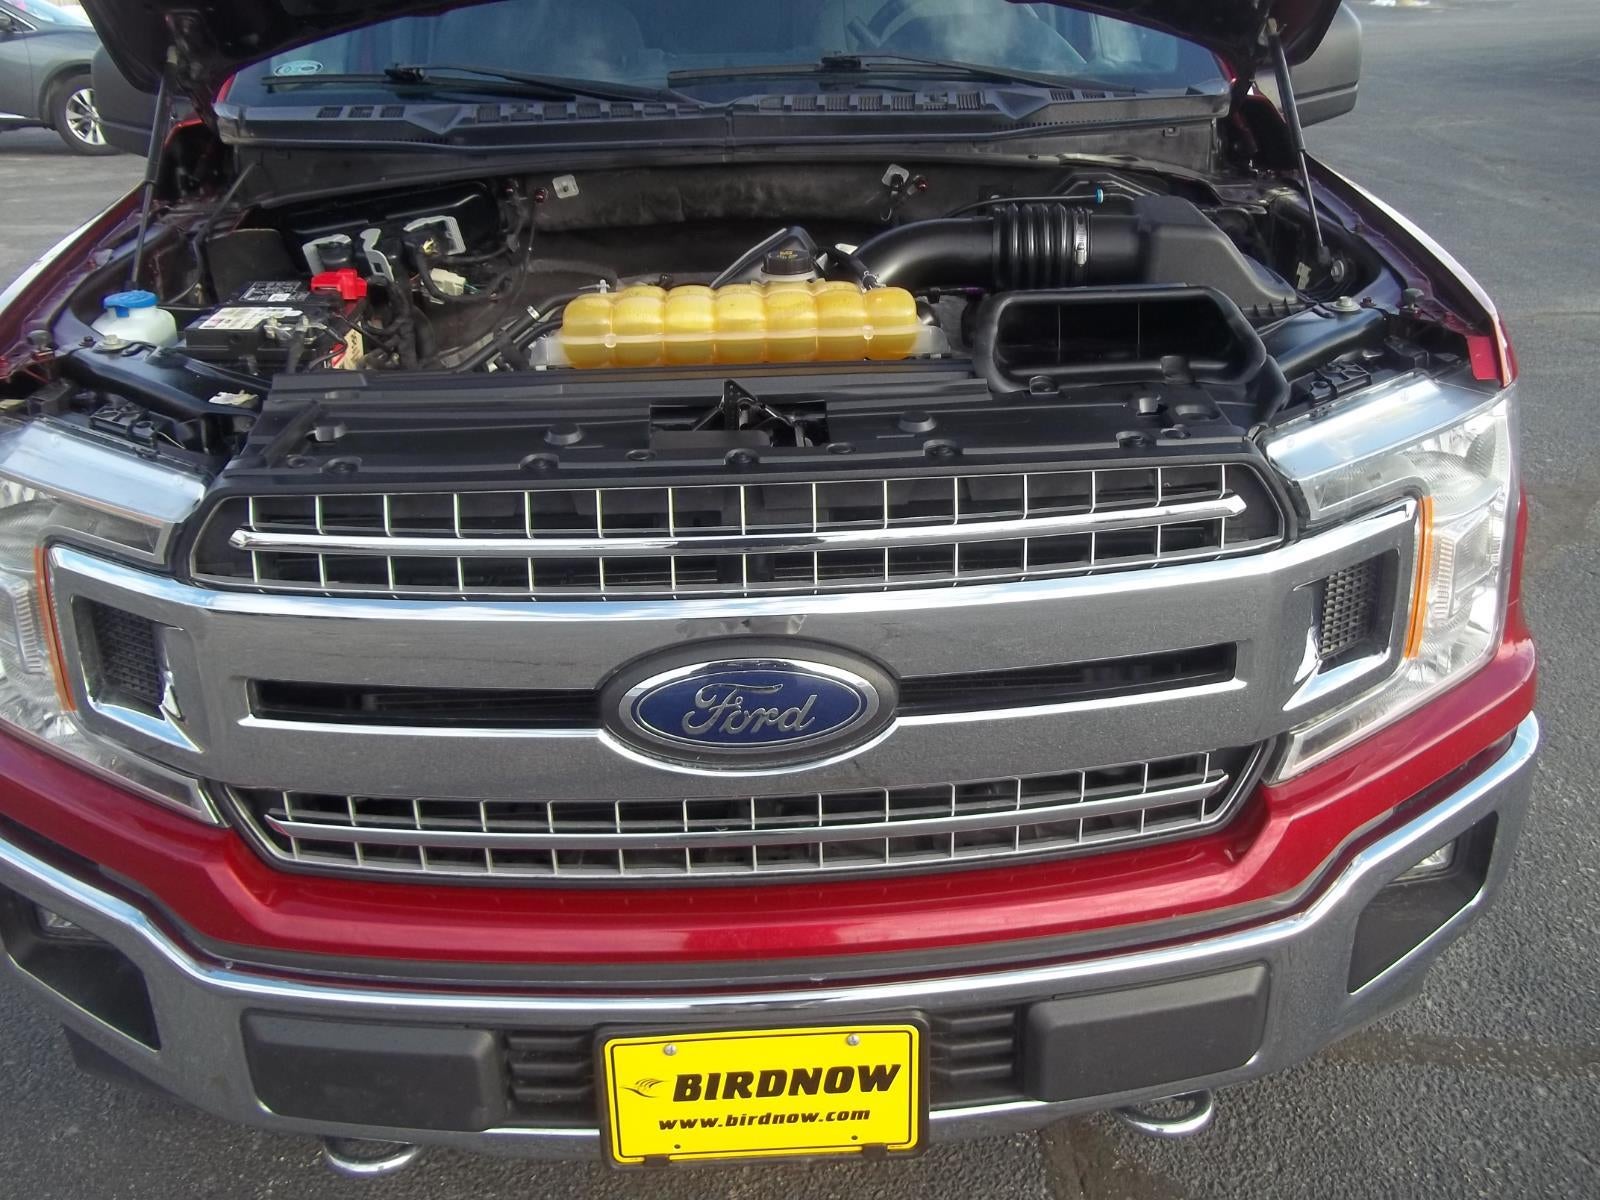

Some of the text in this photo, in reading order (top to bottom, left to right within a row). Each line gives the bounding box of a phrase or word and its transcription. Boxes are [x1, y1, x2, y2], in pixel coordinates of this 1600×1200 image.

[681, 682, 817, 735] Ford
[672, 1063, 902, 1102] BIRDNOW
[658, 1109, 871, 1130] www.birdnow.com
